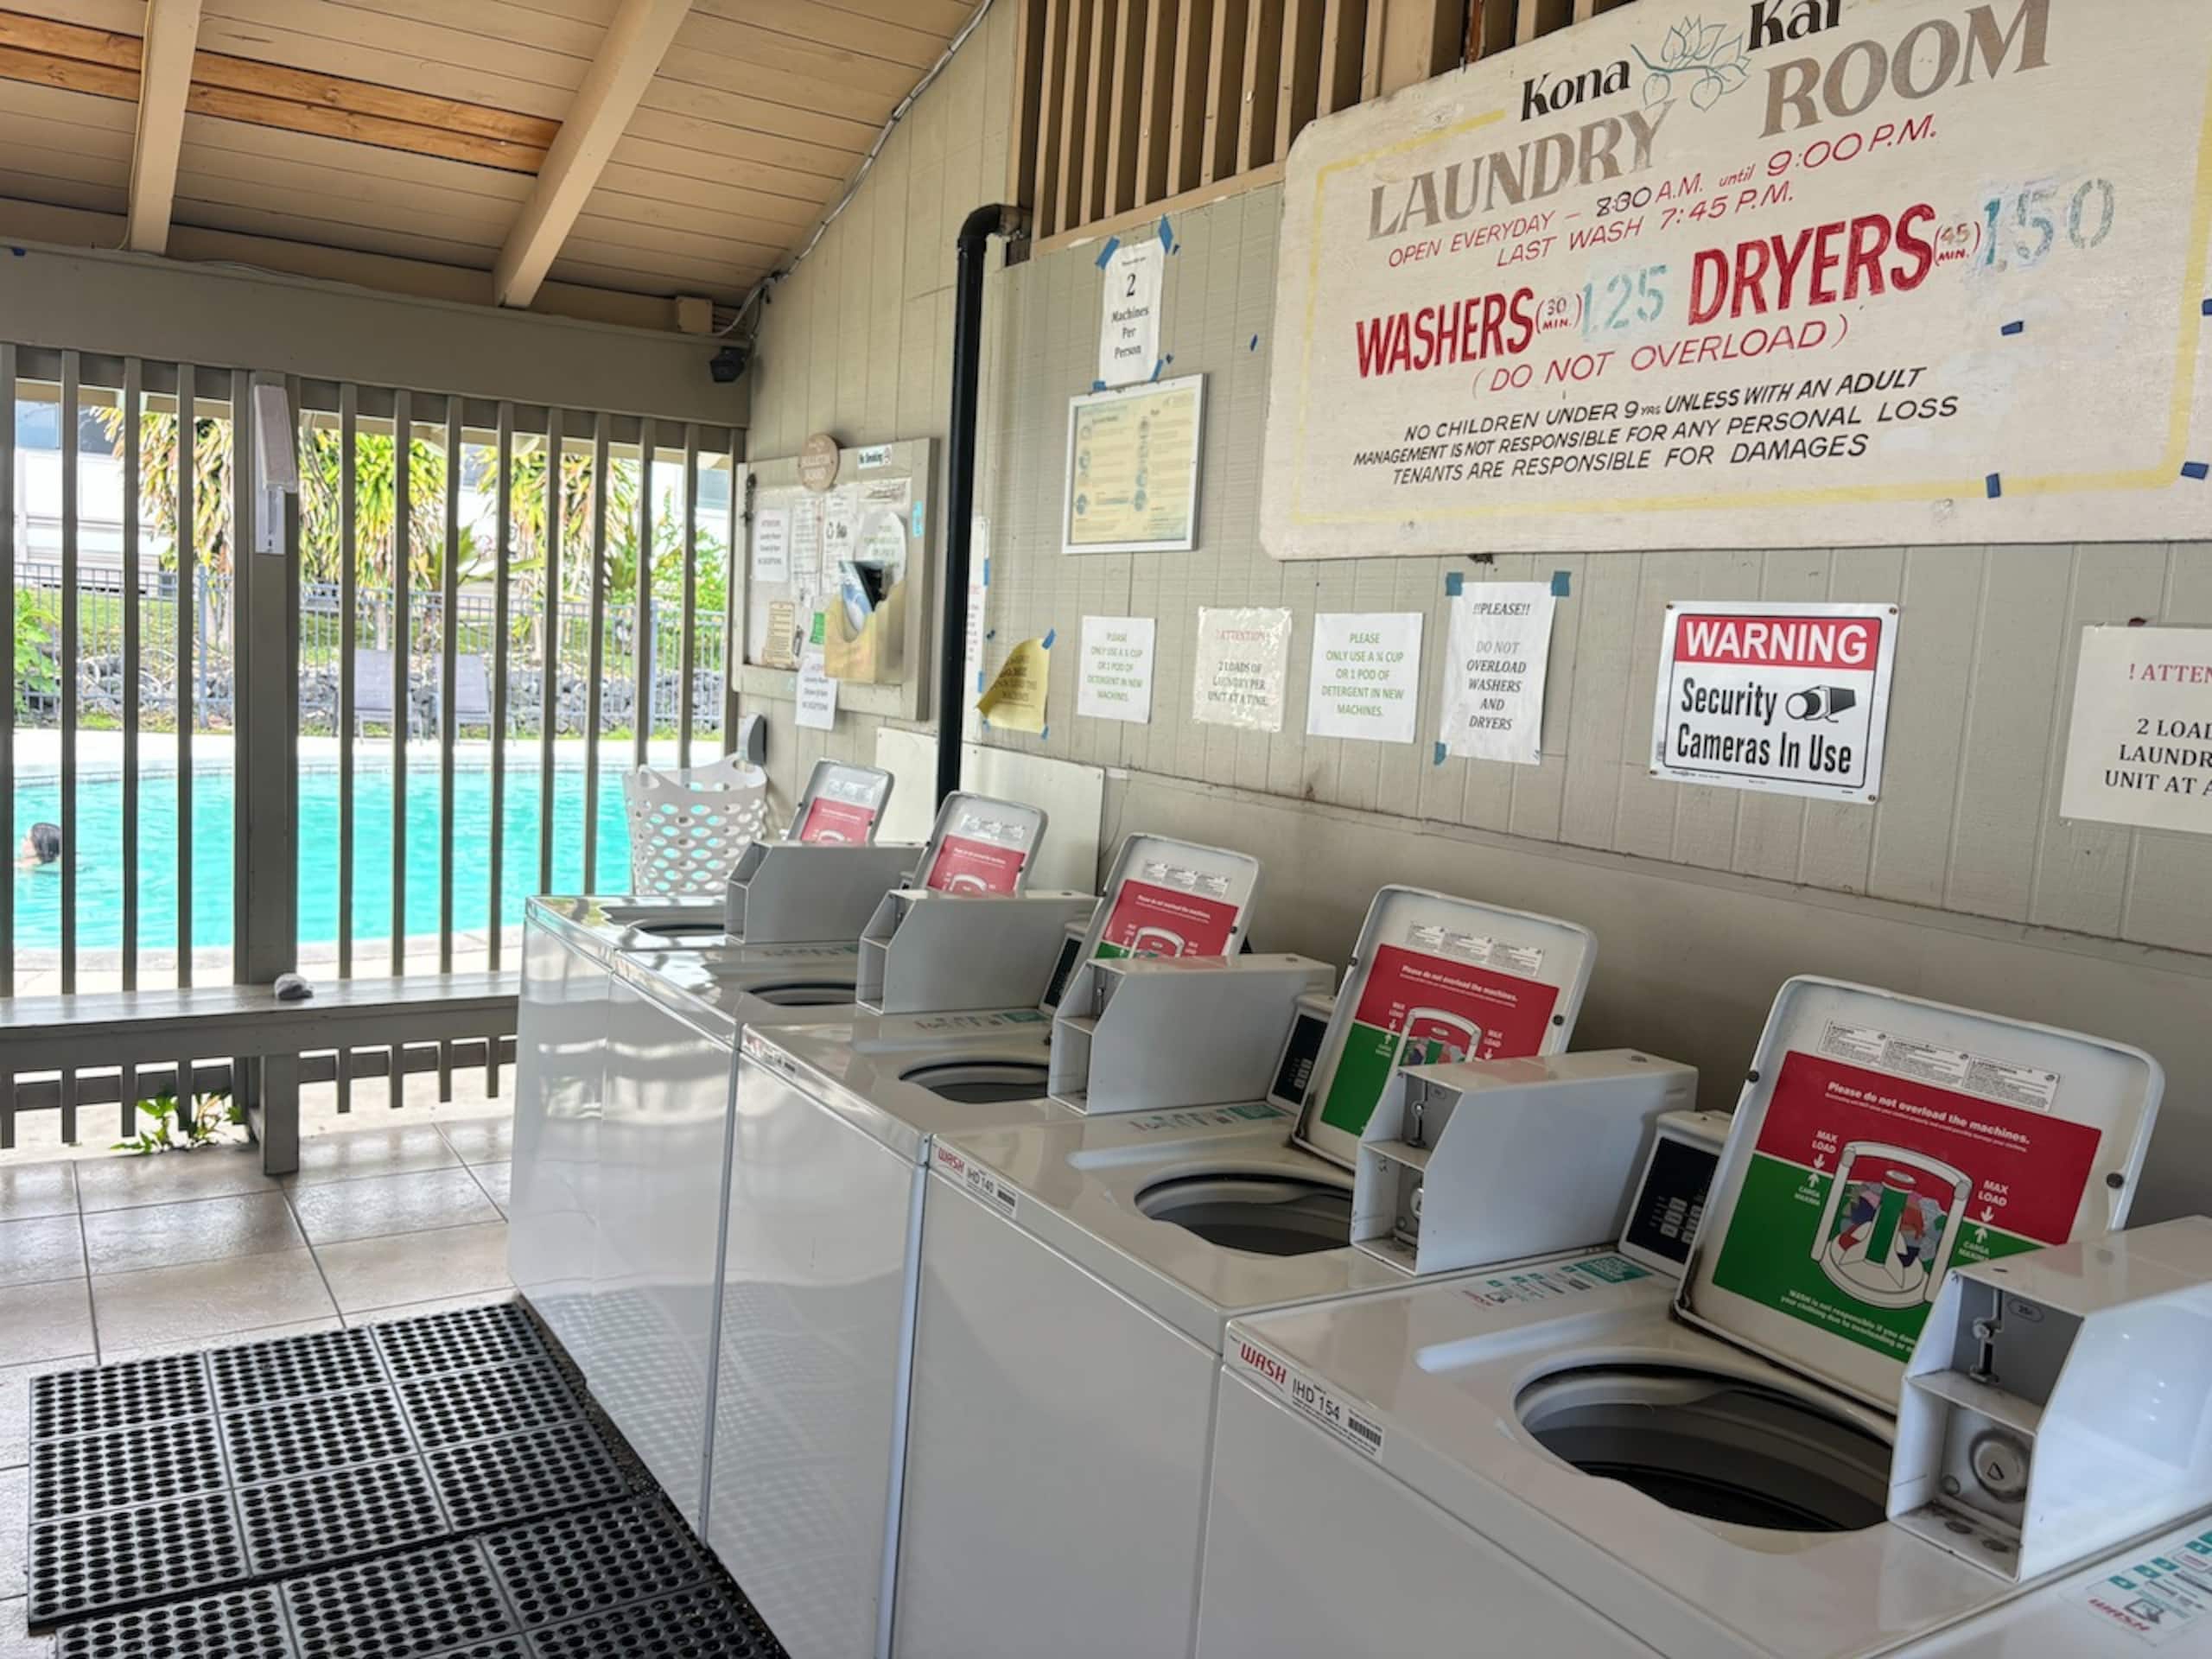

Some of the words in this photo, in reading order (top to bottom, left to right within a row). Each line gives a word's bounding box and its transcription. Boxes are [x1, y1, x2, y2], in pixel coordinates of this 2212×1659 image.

[1520, 60, 1631, 122] Kona
[1367, 99, 1679, 241] LAUNDRY
[1758, 0, 2051, 139] ROOM
[1388, 238, 1442, 268] OPEN
[1450, 210, 1556, 251] EVERYDAY
[1655, 173, 1703, 204] A.M.
[1719, 163, 1756, 188] until
[1766, 132, 1863, 177] 9:00
[1867, 113, 1937, 153] P.M.
[1497, 237, 1556, 268] LAST
[1568, 216, 1645, 251] WASH
[1660, 195, 1729, 231] 7:45
[1735, 180, 1794, 214] P.M.
[1126, 273, 1136, 297] 2
[1355, 286, 1535, 378] WASHERS
[1688, 203, 1936, 326] DRYERS
[1111, 307, 1150, 323] Machines
[1114, 346, 1142, 359] Person
[1544, 351, 1616, 385] NOT
[1404, 423, 1432, 442] NO
[1435, 410, 1541, 439] CHILDREN
[1545, 403, 1619, 426] UNDER
[1624, 400, 1640, 419] 9
[1664, 388, 1741, 414] UNLESS
[1743, 382, 1796, 406] WITH
[1796, 378, 1833, 400] AN
[1835, 366, 1928, 397] ADULT
[1352, 443, 1449, 466] MANAGEMENT
[1450, 442, 1464, 458] IS
[1465, 439, 1496, 457] NOT
[1497, 428, 1622, 454] RESPONSIBLE
[1625, 423, 1669, 442] FOR
[1671, 418, 1722, 440] ANY
[1726, 405, 1862, 435] PERSONAL
[1877, 395, 1960, 423] LOSS
[1393, 463, 1464, 485] TENANTS
[1465, 460, 1506, 480] ARE
[1511, 449, 1652, 477] RESPONSIBLE
[1664, 444, 1714, 467] FOR
[1729, 433, 1870, 464] DAMAGES
[1349, 632, 1382, 644] PLEASE
[1476, 640, 1492, 654] DO
[1495, 641, 1521, 655] NOT
[1686, 620, 1868, 664] WARNING
[1325, 650, 1349, 662] ONLY
[1350, 650, 1366, 663] USE
[1385, 651, 1404, 664] CUP
[1466, 659, 1528, 674] OVERLOAD
[1321, 684, 1370, 698] DETERGENT
[1382, 689, 1404, 700] NEW
[1468, 677, 1522, 694] WASHERS
[1479, 697, 1505, 711] AND
[1681, 677, 1778, 727] Security
[1469, 715, 1514, 731] DRYERS
[2137, 718, 2149, 734] 2
[1675, 722, 1771, 766] Cameras
[1779, 731, 1802, 769] In
[1808, 734, 1853, 775] Use
[2104, 769, 2160, 791] UNIT
[2164, 776, 2197, 795] AT
[1827, 1081, 1863, 1098] Please
[1864, 1091, 1878, 1103] do
[1878, 1096, 1897, 1108] not
[1898, 1102, 1948, 1122] overload
[1948, 1114, 1968, 1127] the
[1812, 1140, 1837, 1154] LOAD
[1815, 1130, 1839, 1144] MAX
[1978, 1192, 2008, 1207] LOAD
[1983, 1179, 2009, 1195] MAX
[1240, 1342, 1287, 1384] WASH
[1319, 1395, 1341, 1421] 154
